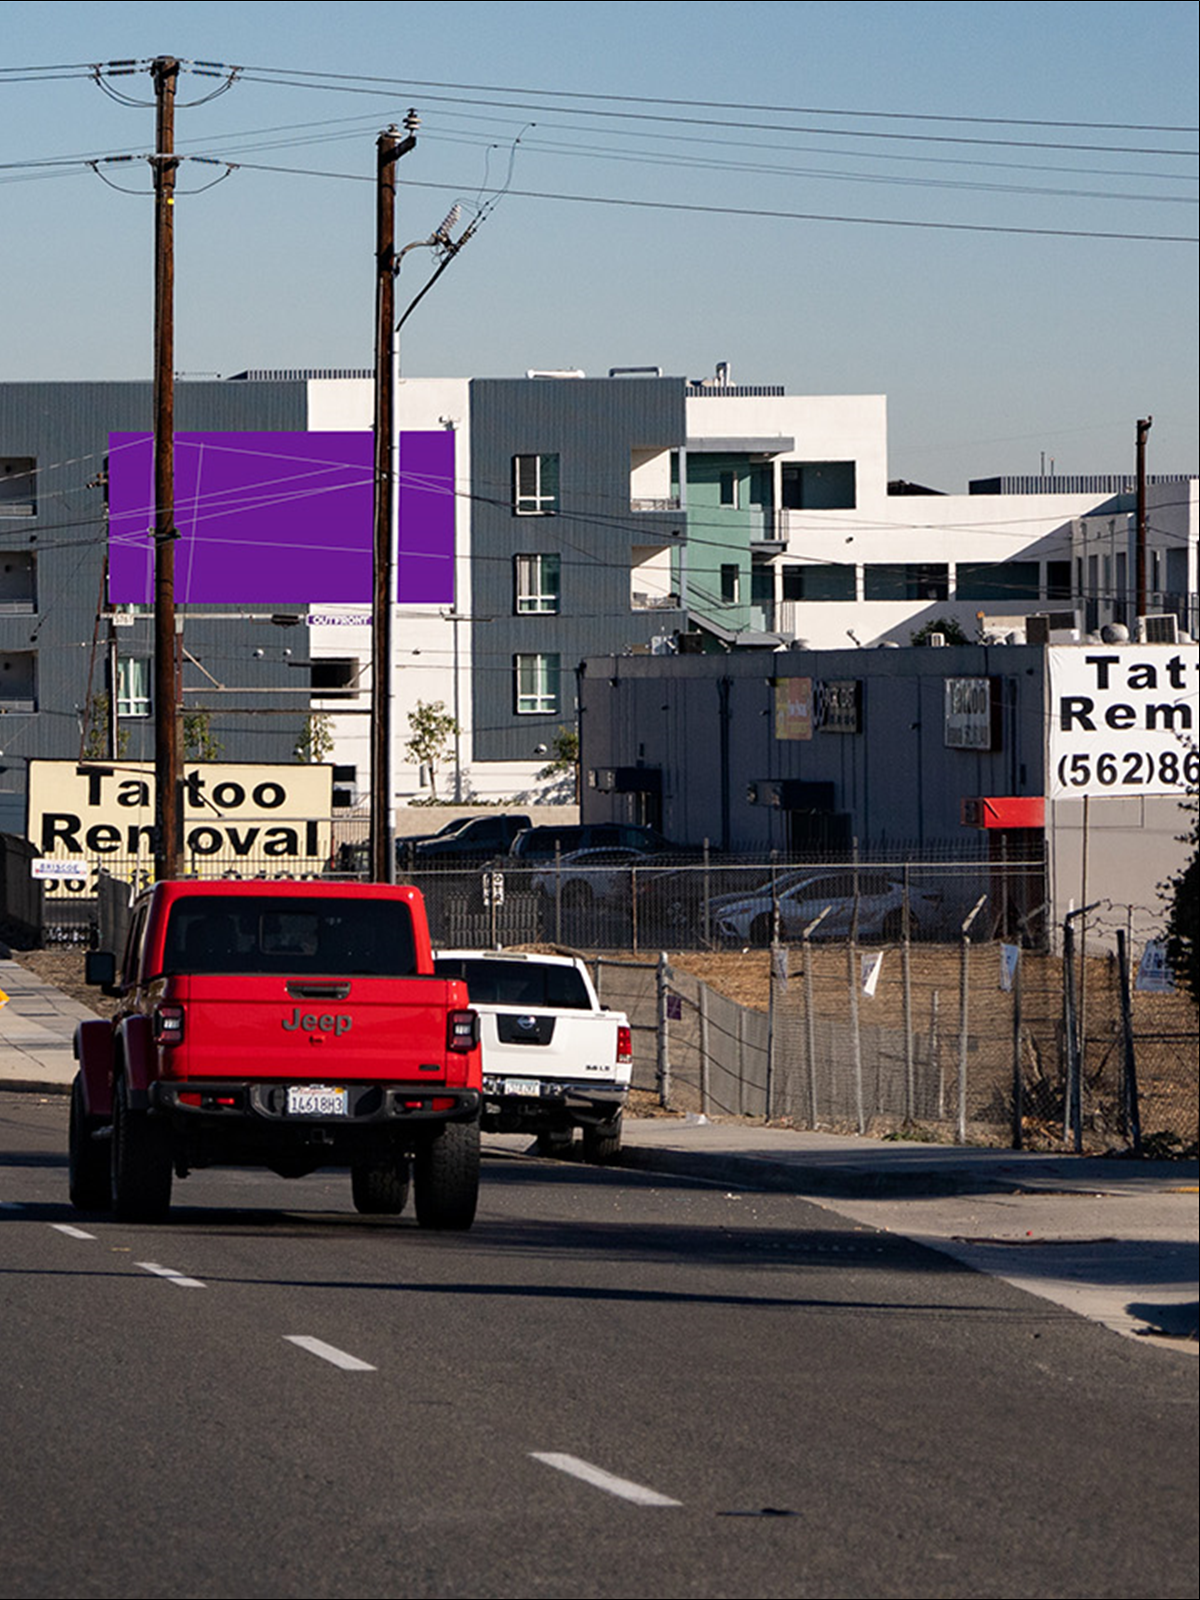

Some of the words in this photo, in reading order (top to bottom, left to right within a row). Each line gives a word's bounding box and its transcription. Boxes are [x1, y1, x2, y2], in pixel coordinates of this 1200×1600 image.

[311, 614, 371, 625] OUTFRONT
[1085, 655, 1200, 690] Tat
[1060, 696, 1192, 731] Rem
[76, 766, 286, 809] Tatoo
[282, 1008, 352, 1036] Jeep
